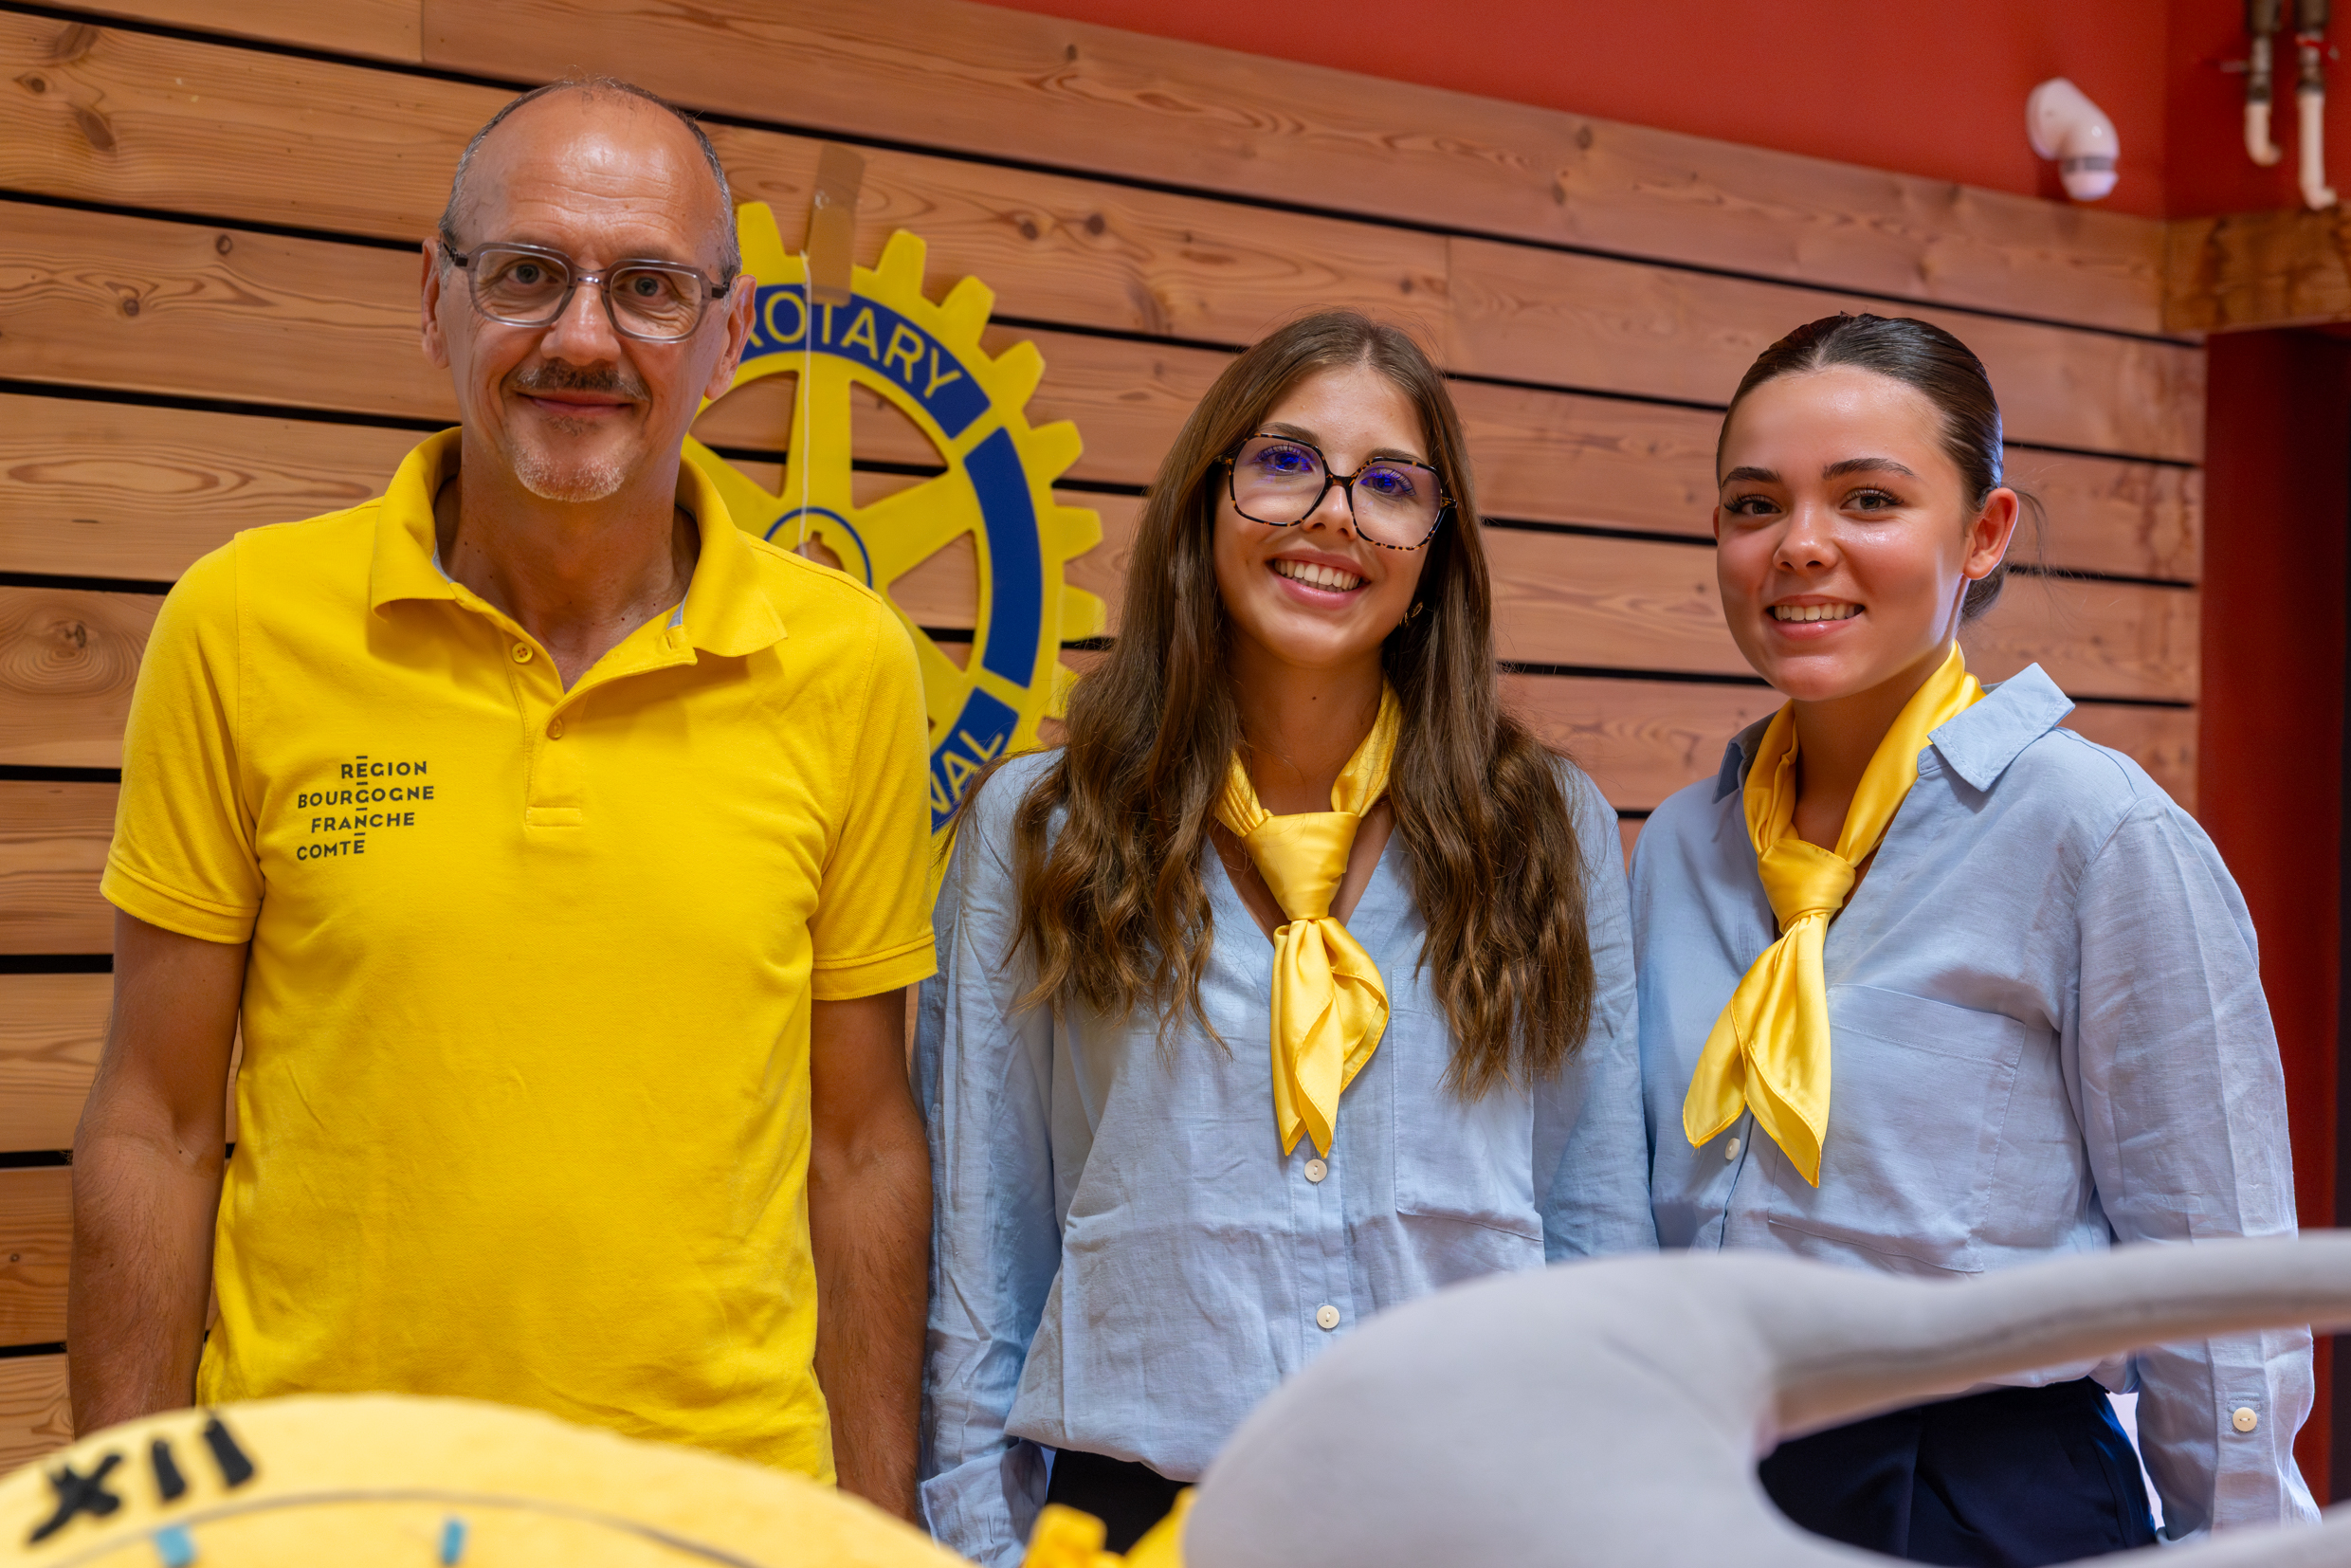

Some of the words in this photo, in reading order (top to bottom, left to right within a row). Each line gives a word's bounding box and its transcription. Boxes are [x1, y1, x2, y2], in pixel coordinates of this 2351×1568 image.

[749, 291, 962, 398] OTARY
[298, 786, 434, 809] BOURGOGNE
[311, 812, 415, 833] FRANCHE
[27, 1413, 255, 1546] XII
